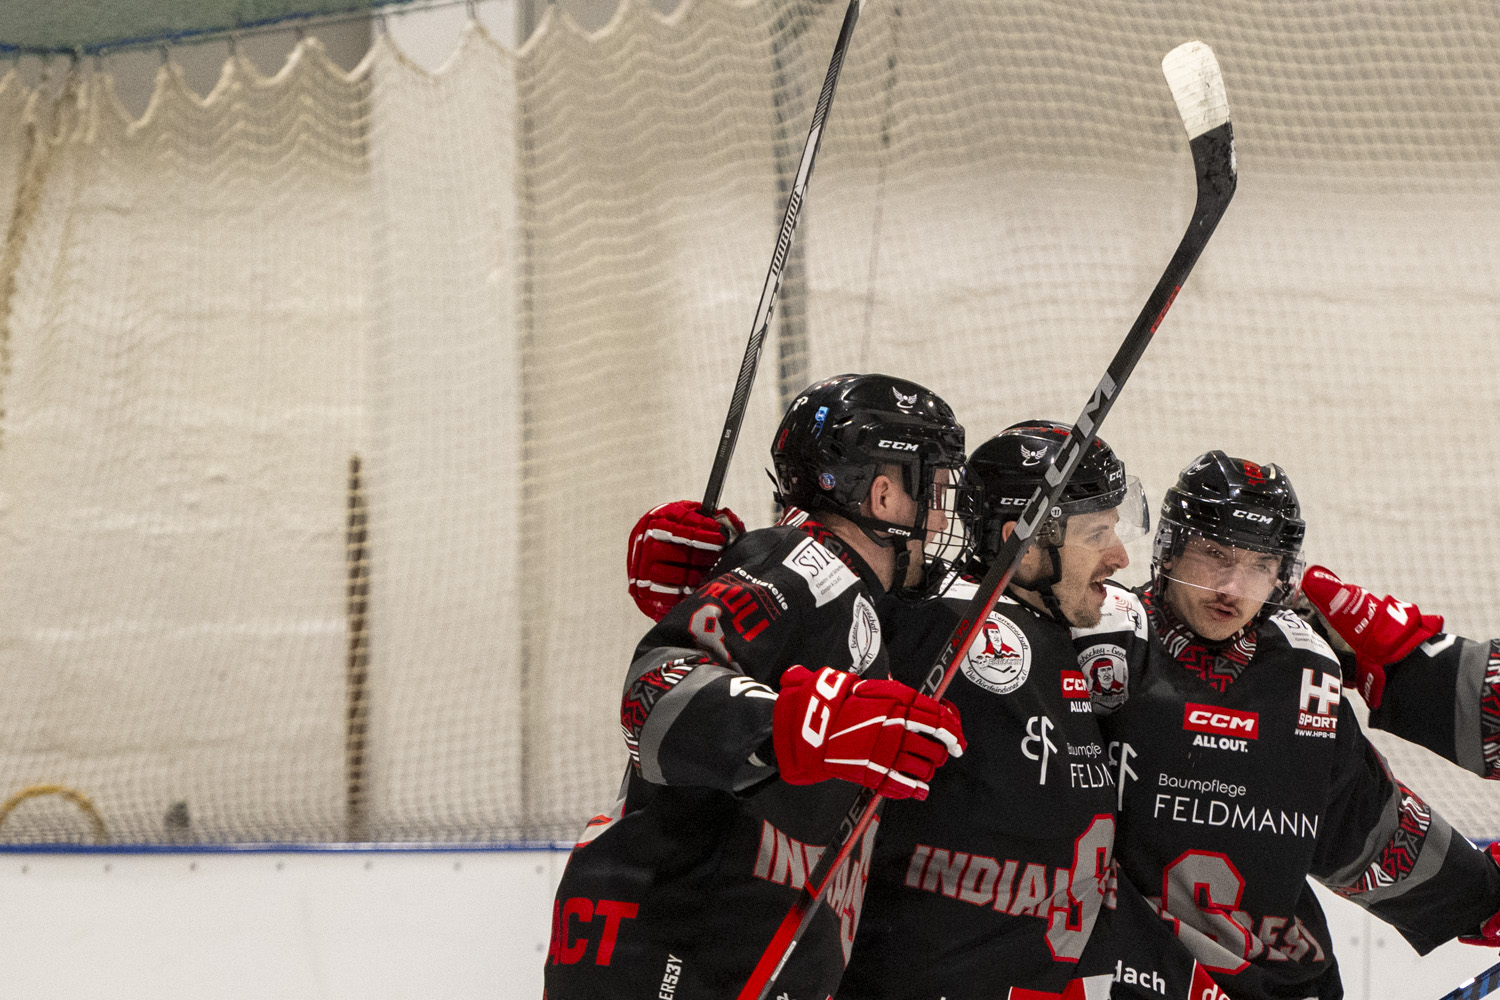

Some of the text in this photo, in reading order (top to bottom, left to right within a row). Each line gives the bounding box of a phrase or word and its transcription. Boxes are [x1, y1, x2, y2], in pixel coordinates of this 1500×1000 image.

[878, 439, 919, 452] CCM
[1014, 371, 1118, 541] CCM
[1000, 497, 1029, 506] CC
[1232, 509, 1274, 525] CCM
[887, 527, 912, 537] CCM
[1299, 667, 1341, 715] HP
[802, 667, 847, 749] CC
[1187, 710, 1256, 733] CCM
[1298, 712, 1338, 729] SPORT
[1193, 734, 1249, 754] ALL OUT.
[1158, 773, 1247, 798] Baumpflege
[1153, 794, 1320, 840] FELDMANN
